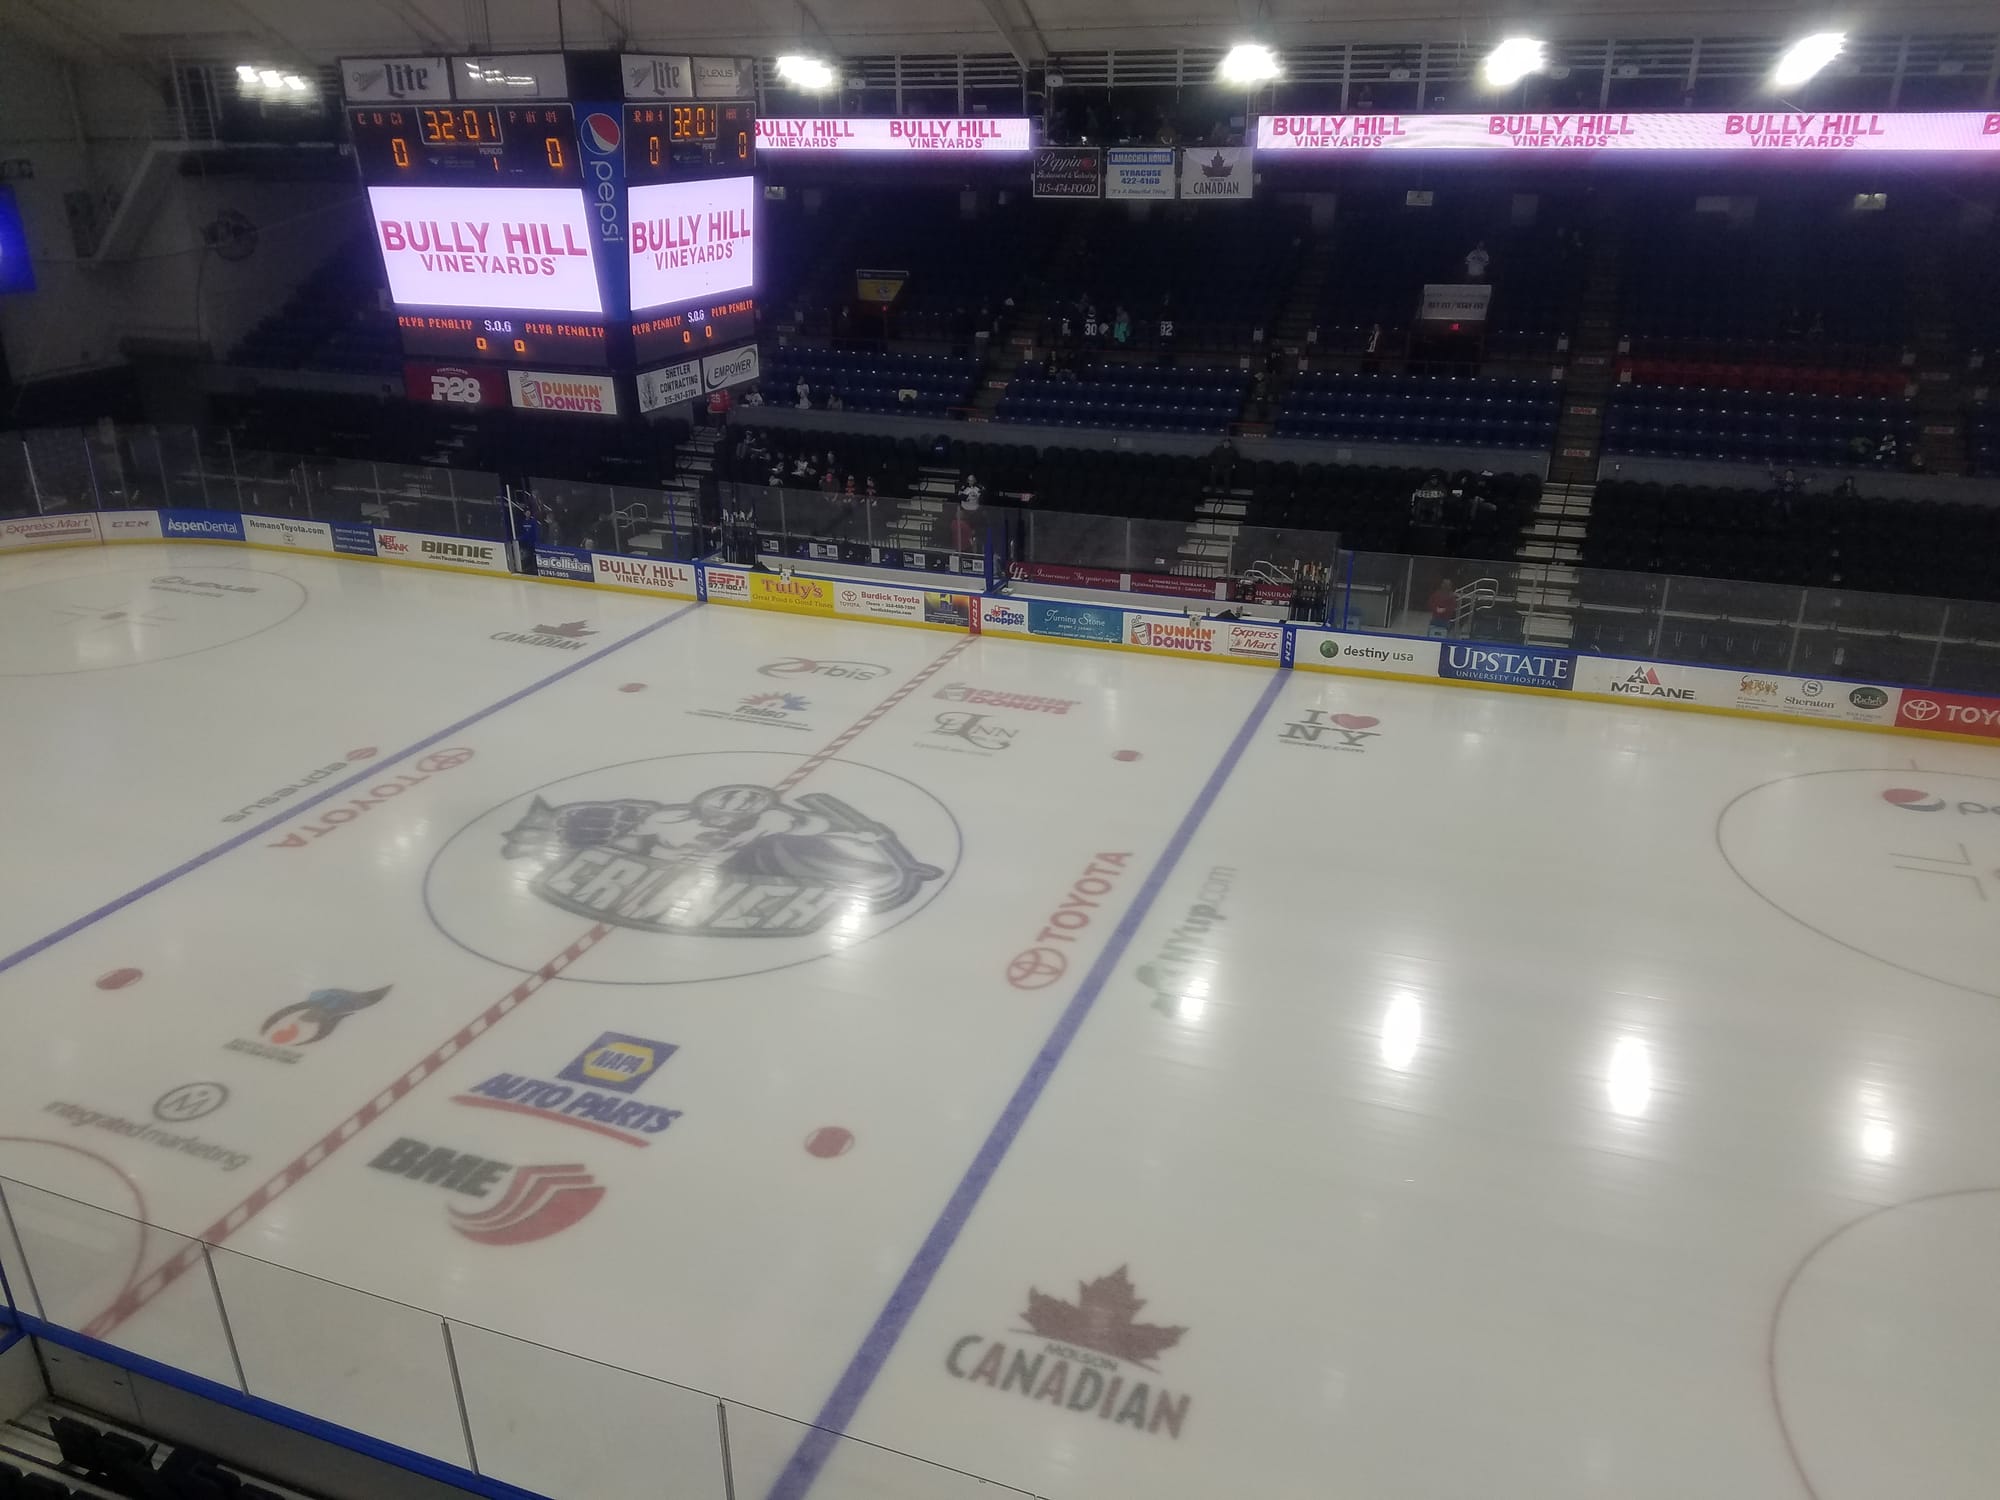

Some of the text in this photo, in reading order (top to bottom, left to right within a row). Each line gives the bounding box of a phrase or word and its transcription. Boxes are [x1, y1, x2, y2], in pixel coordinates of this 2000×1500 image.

[384, 63, 428, 98] Lite
[651, 60, 680, 95] Lite
[424, 110, 496, 139] 32:01
[813, 121, 855, 138] HILL
[890, 121, 1002, 139] BULLY HILL
[1271, 116, 1405, 136] BULLY HILL
[1488, 115, 1635, 136] BULLY HILL
[1725, 114, 1885, 136] BULLY HILL
[739, 131, 747, 158] 0
[767, 137, 839, 148] VINEYARDS
[909, 138, 985, 149] VINEYARDS
[1294, 135, 1384, 148] VINEYARDS
[1511, 134, 1610, 148] VINEYARDS
[1750, 134, 1858, 148] VINEYARDS
[391, 138, 409, 167] 0
[545, 138, 564, 167] 0
[650, 136, 660, 165] 0
[1119, 169, 1161, 177] SYRACUSE
[1193, 182, 1240, 195] CANADIAN
[590, 161, 624, 241] pepsi
[380, 221, 587, 256] BULLY HILL
[631, 208, 751, 254] BULLY HILL
[420, 254, 556, 276] VINEYARDS
[654, 241, 734, 271] VINEYARDS
[428, 318, 473, 330] PENALTY
[557, 324, 605, 338] PENALTY
[652, 315, 681, 331] PENALTY
[705, 325, 713, 338] 0
[475, 336, 488, 351] 0
[513, 338, 526, 353] 0
[683, 330, 690, 343] 0
[665, 363, 690, 379] SHETLER
[714, 359, 752, 379] EMPOWER
[430, 375, 481, 404] P28
[542, 381, 603, 398] DUNKIN'
[660, 375, 698, 394] CONTRACTING
[542, 397, 602, 412] DONUTS
[57, 518, 90, 529] Mart
[385, 543, 409, 553] BANK
[421, 540, 493, 560] BIRNIE
[550, 557, 592, 573] Collision
[599, 560, 688, 581] BULLY HILL
[615, 573, 674, 588] VINEYARDS
[708, 572, 745, 586] ESPN
[761, 578, 824, 599] Tully's
[861, 591, 920, 606] Burdick Toyota
[984, 613, 1025, 626] Chopper
[1001, 609, 1025, 620] Price
[1044, 609, 1105, 627] Turning Stone
[489, 631, 588, 650] CANADIAN
[1153, 623, 1216, 640] DUNKIN'
[1231, 627, 1279, 640] Express
[1152, 636, 1212, 652] DONUTS
[1244, 639, 1277, 650] Mart
[1344, 645, 1414, 662] destiny usa
[1448, 645, 1568, 679] UPSTATE
[1456, 670, 1558, 688] UNIVERSITY HOSPITAL
[1611, 682, 1696, 700] McLANE
[1784, 696, 1835, 709] Sheraton
[1300, 709, 1328, 725] I
[1278, 722, 1382, 746] NY
[267, 774, 431, 848] TOYOTA
[1036, 851, 1133, 943] TOYOTA
[591, 1047, 646, 1075] NAPA
[469, 1072, 683, 1133] AUTO PARTS
[366, 1137, 514, 1198] BME
[946, 1334, 1192, 1439] CANADIAN
